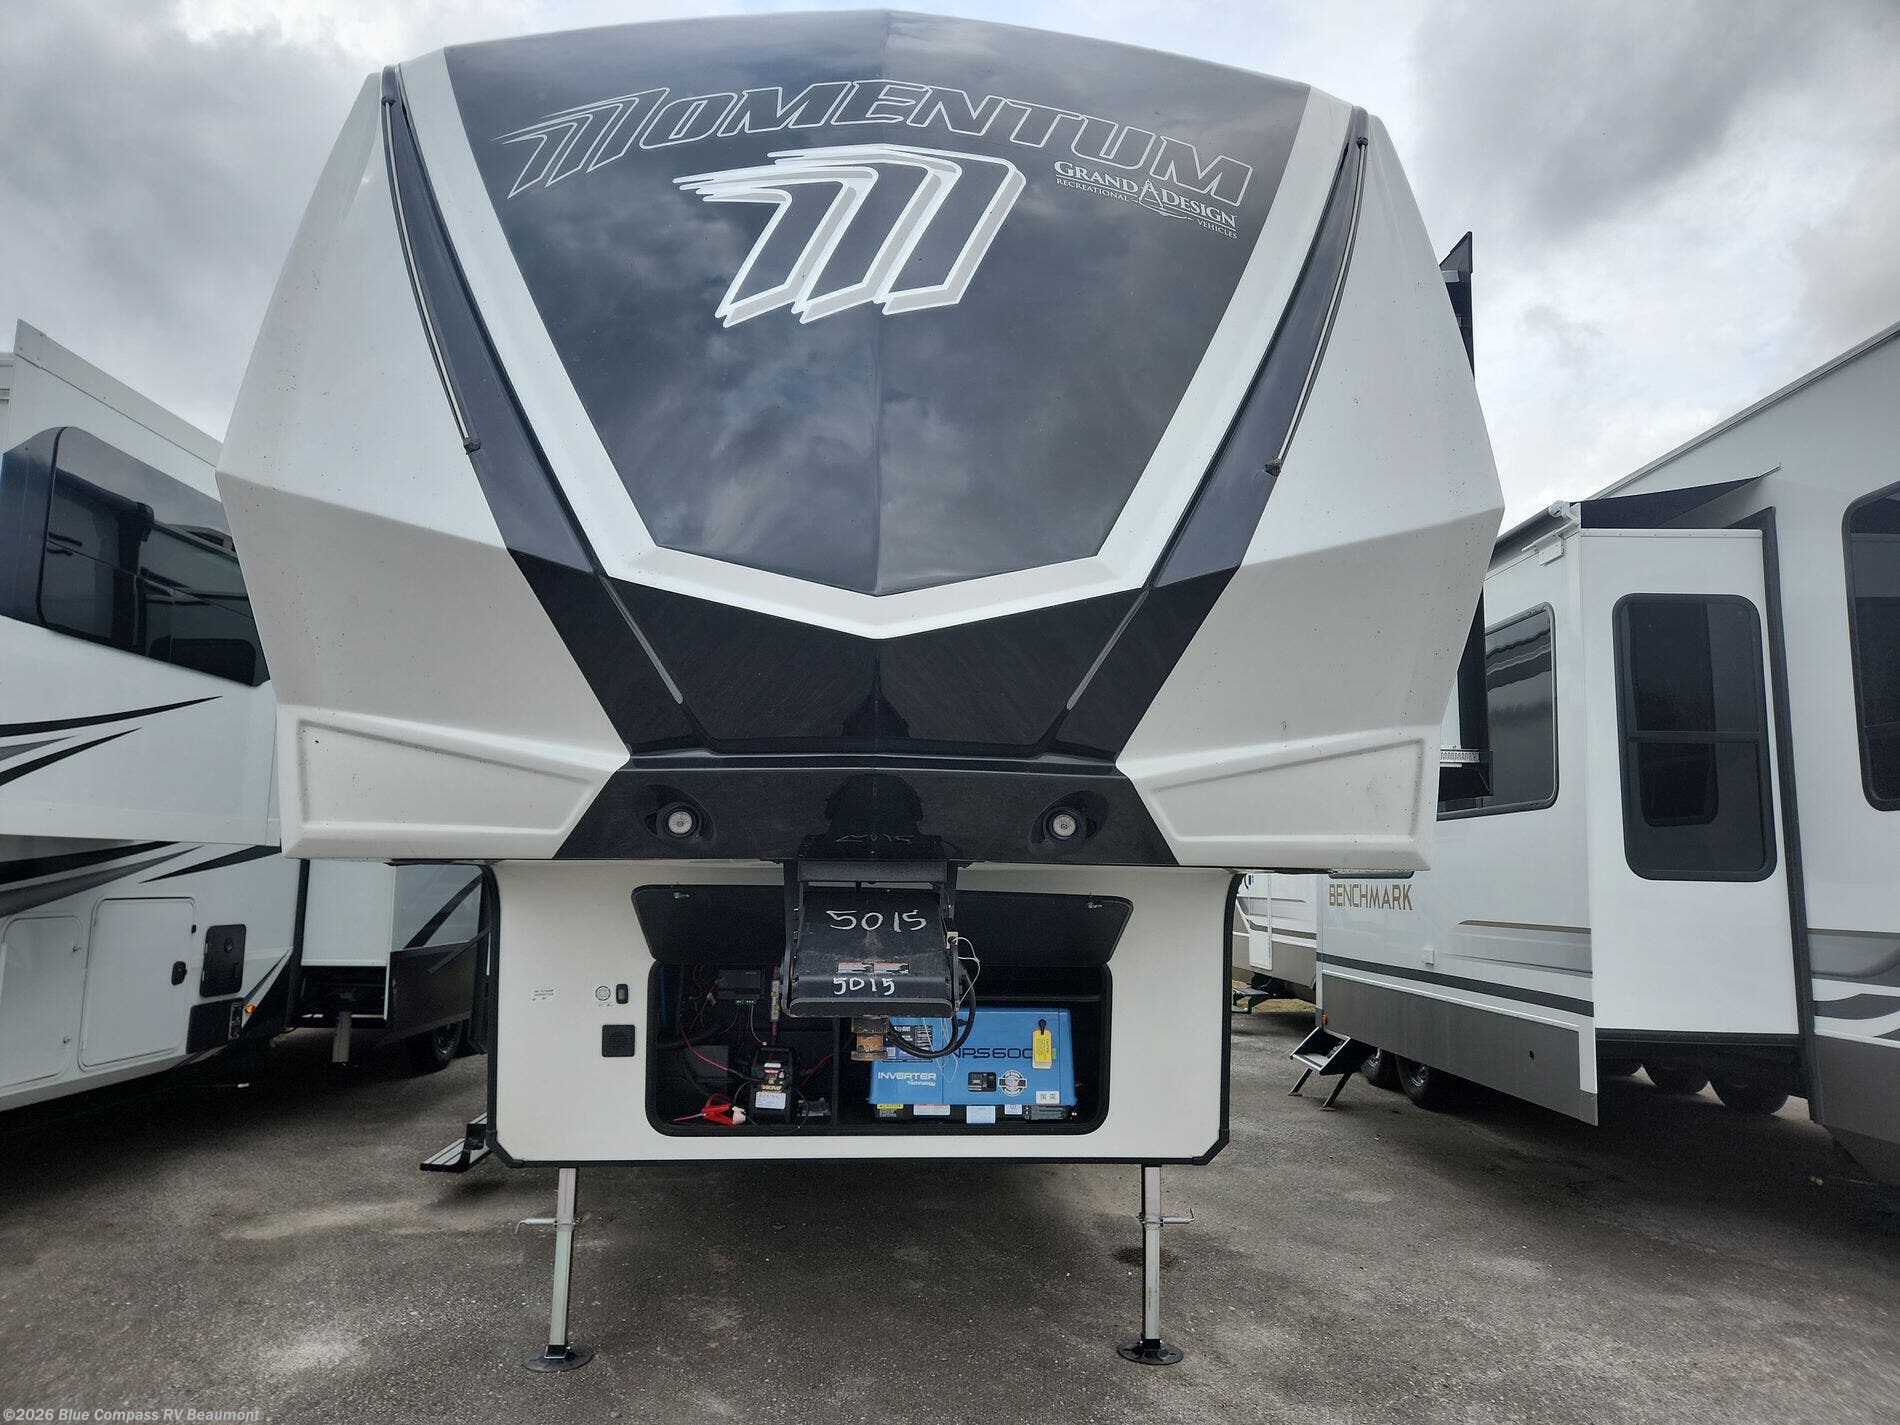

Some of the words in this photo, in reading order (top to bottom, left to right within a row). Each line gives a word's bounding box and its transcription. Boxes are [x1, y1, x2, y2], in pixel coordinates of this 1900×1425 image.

[491, 78, 1253, 206] MOMENTUM
[1054, 160, 1139, 194] GRAND
[1160, 187, 1237, 228] DESIGN
[1056, 177, 1129, 202] RECREATIONAL
[1197, 218, 1238, 239] VEHICLES
[1328, 883, 1414, 911] BENCHMARK
[826, 909, 927, 932] 5015
[833, 977, 895, 995] 5015
[877, 1071, 937, 1080] INVERTER
